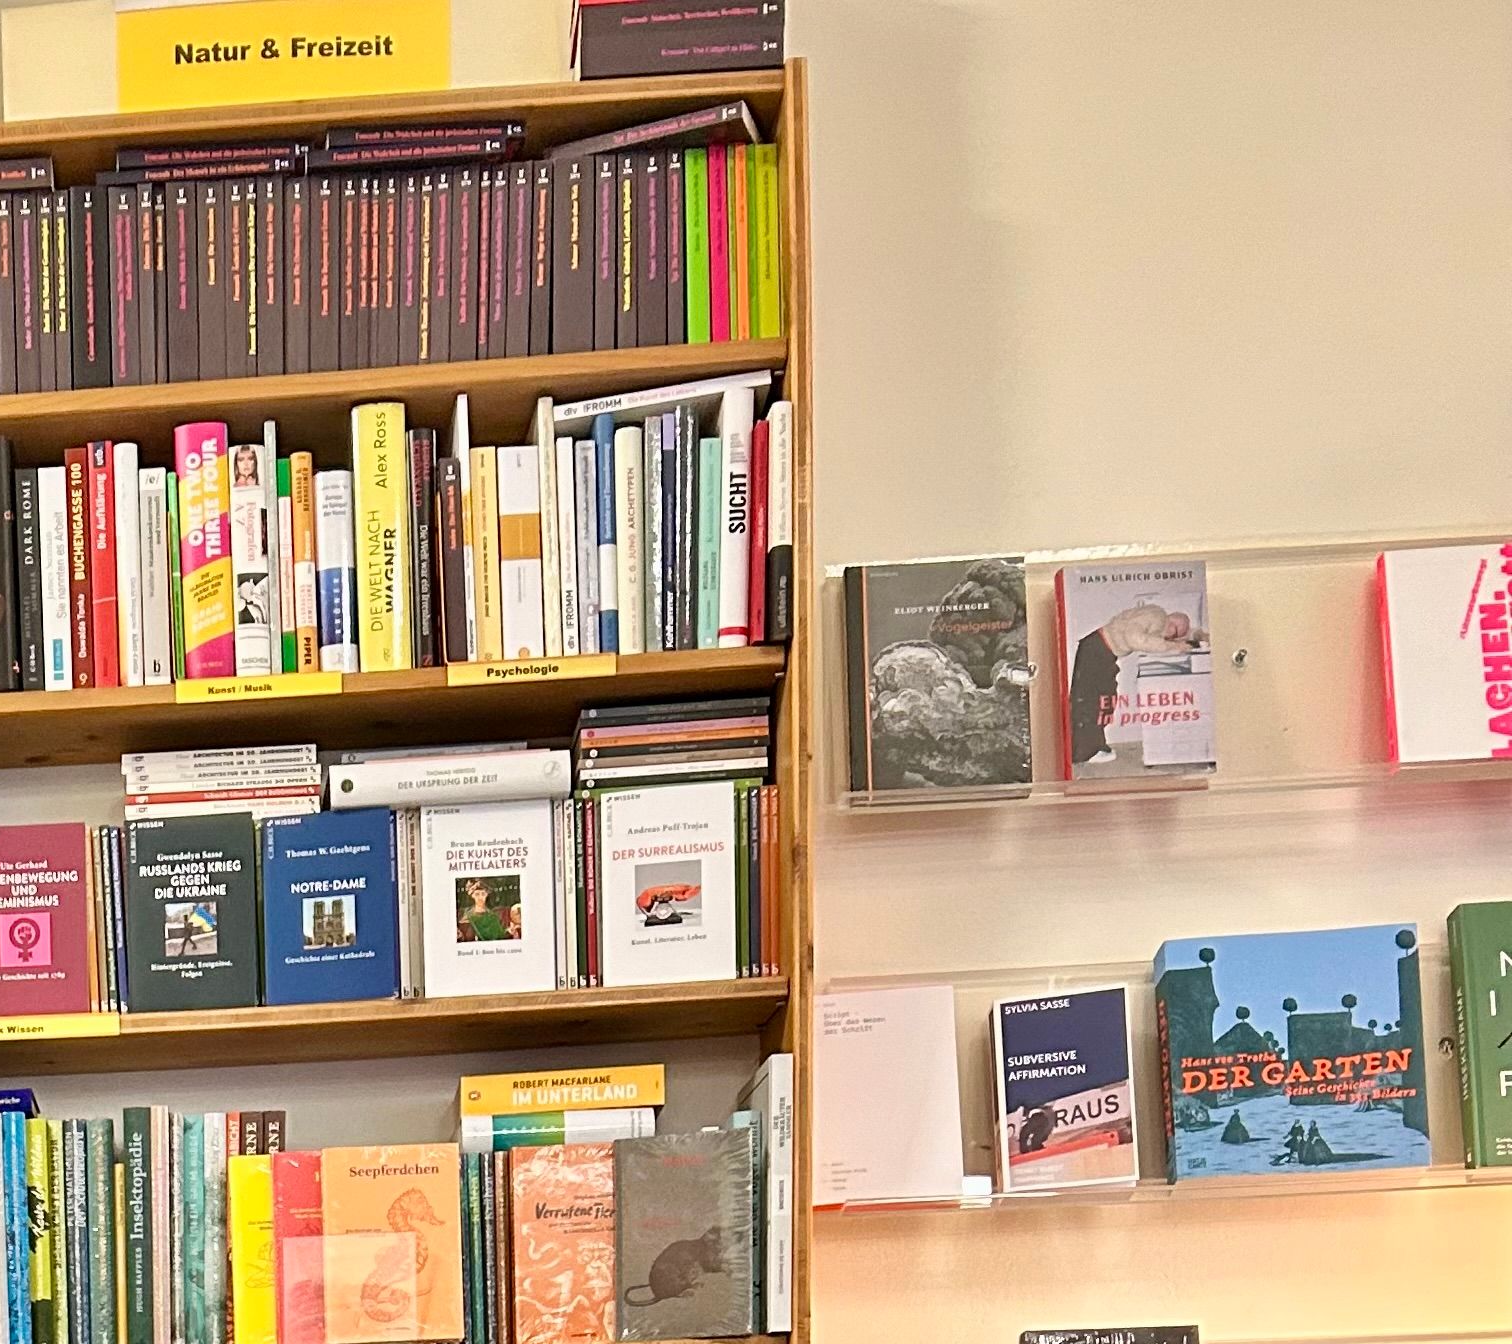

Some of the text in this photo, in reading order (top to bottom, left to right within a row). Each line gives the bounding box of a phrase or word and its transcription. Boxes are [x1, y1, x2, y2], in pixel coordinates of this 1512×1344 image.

[174, 36, 393, 65] Natur & Freizeit
[374, 412, 388, 489] Alex Ross
[729, 472, 747, 534] SUCHT
[72, 463, 87, 581] BUCHENGASSE 100
[368, 560, 381, 606] WELT
[1079, 569, 1194, 585] HANS ULRICH OBRIST
[936, 618, 1014, 635] Vogelgeister
[486, 662, 560, 679] Psychologie
[208, 684, 272, 695] Kunst Musik
[1098, 690, 1195, 710] EIN LEBEN
[1119, 706, 1202, 728] progress
[157, 852, 199, 862] Gwendolyn
[446, 846, 529, 860] DIE KUNST DES
[612, 842, 725, 861] DER SURREALISMUS
[0, 860, 48, 870] Ute Gerhard
[139, 860, 241, 877] RUSSLANDS KRIEG
[448, 858, 527, 872] MITTELALTERS
[170, 874, 210, 886] GEGEN
[290, 878, 366, 894] NOTRE-DAME
[11, 884, 37, 895] UND
[155, 884, 226, 899] DIE UKRAINE
[1004, 998, 1071, 1016] SYLVIA SASSE
[6, 1024, 44, 1034] Wissen
[1007, 1051, 1077, 1069] SUBVERSIVE
[1008, 1064, 1087, 1083] AFFIRMATION
[1182, 1048, 1413, 1094] DER GARTEN
[512, 1079, 550, 1090] ROBERT
[512, 1083, 638, 1107] IM UNTERLAND
[1053, 1094, 1120, 1127] RAUS
[348, 1163, 440, 1179] Seepferdchen
[129, 1132, 148, 1240] Insektopädie
